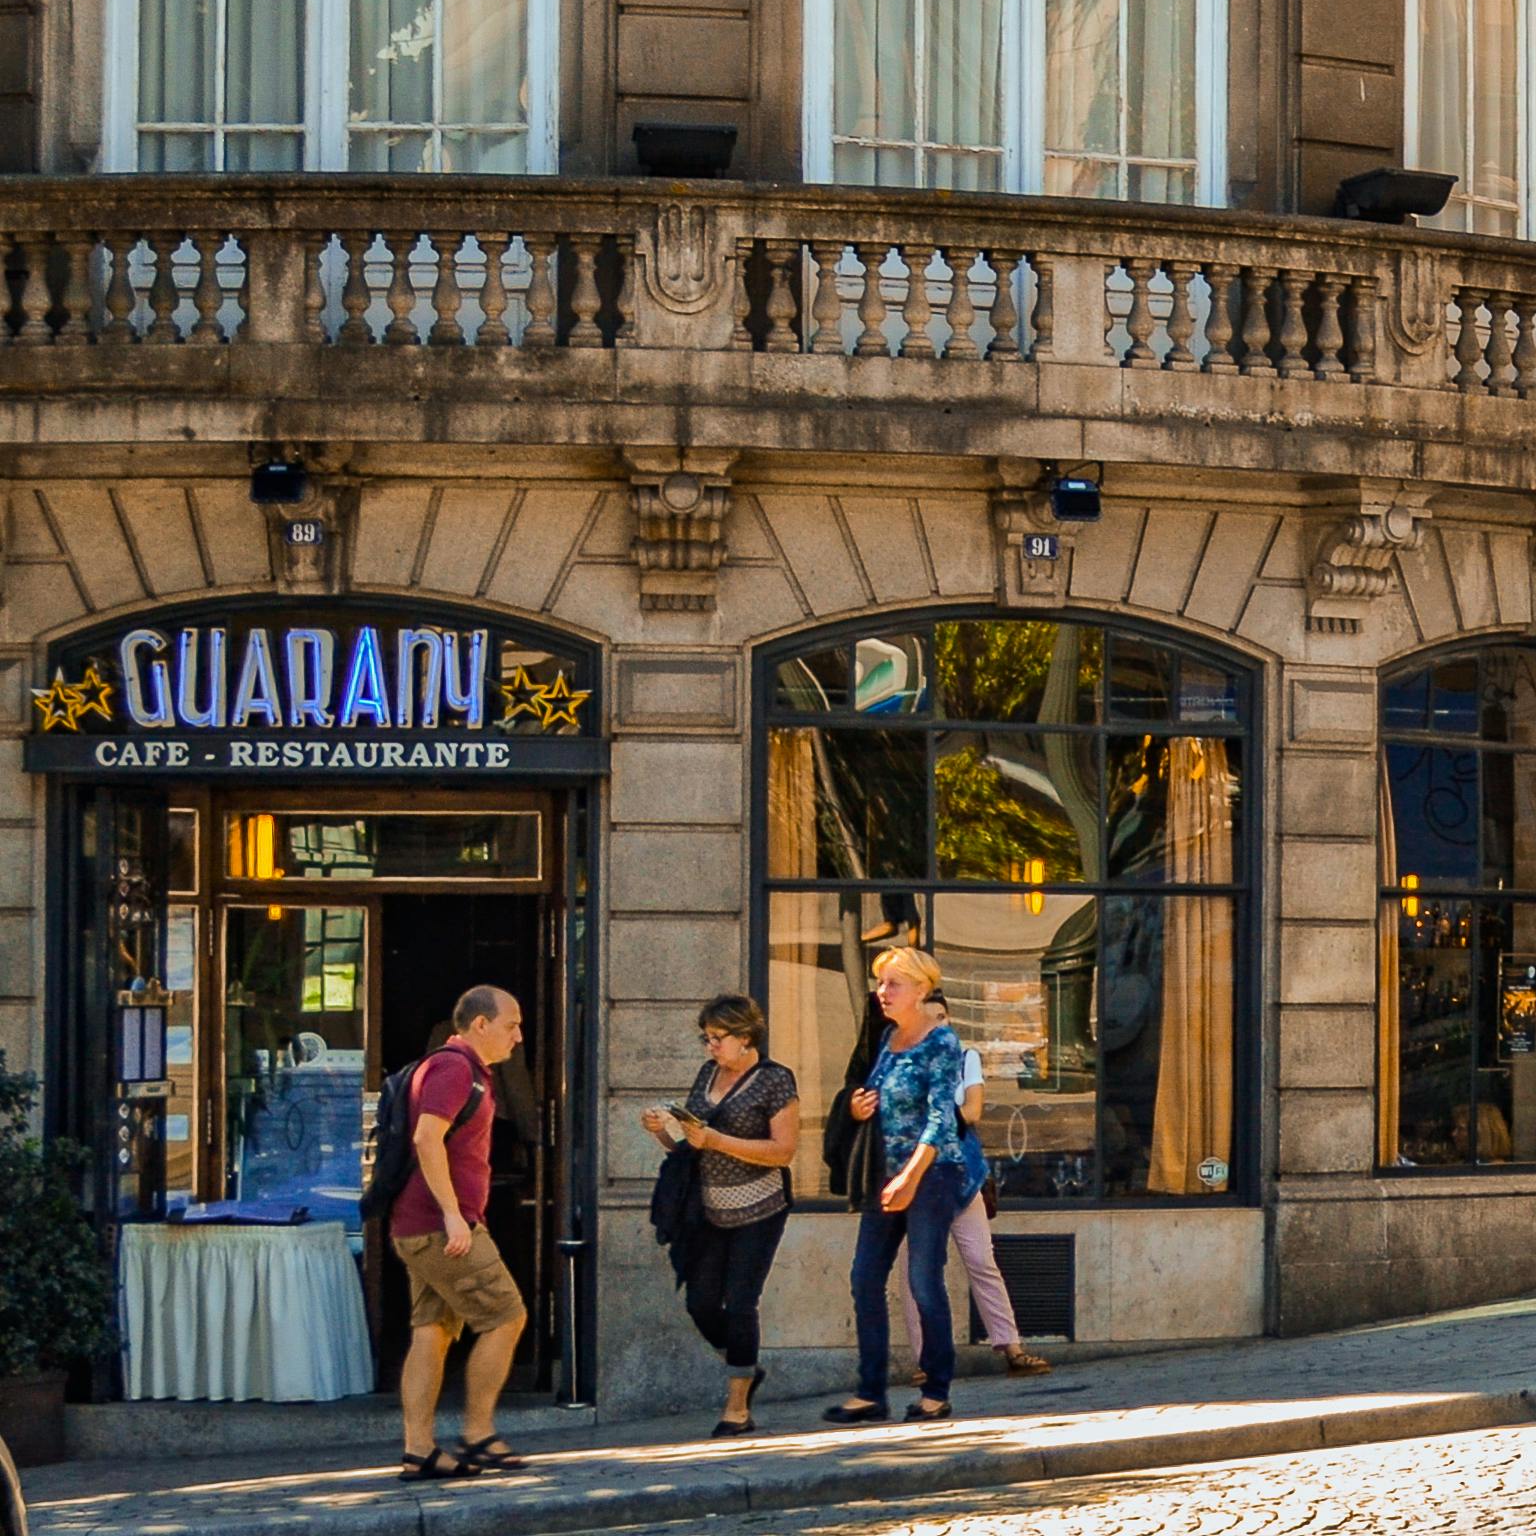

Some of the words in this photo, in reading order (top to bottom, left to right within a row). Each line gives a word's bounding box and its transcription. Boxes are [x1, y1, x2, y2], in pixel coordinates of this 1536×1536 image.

[292, 523, 315, 542] 89
[1031, 537, 1051, 557] 91
[119, 626, 488, 730] GUARANY
[95, 741, 191, 768] CAFE
[229, 741, 511, 769] RESTAURANTE
